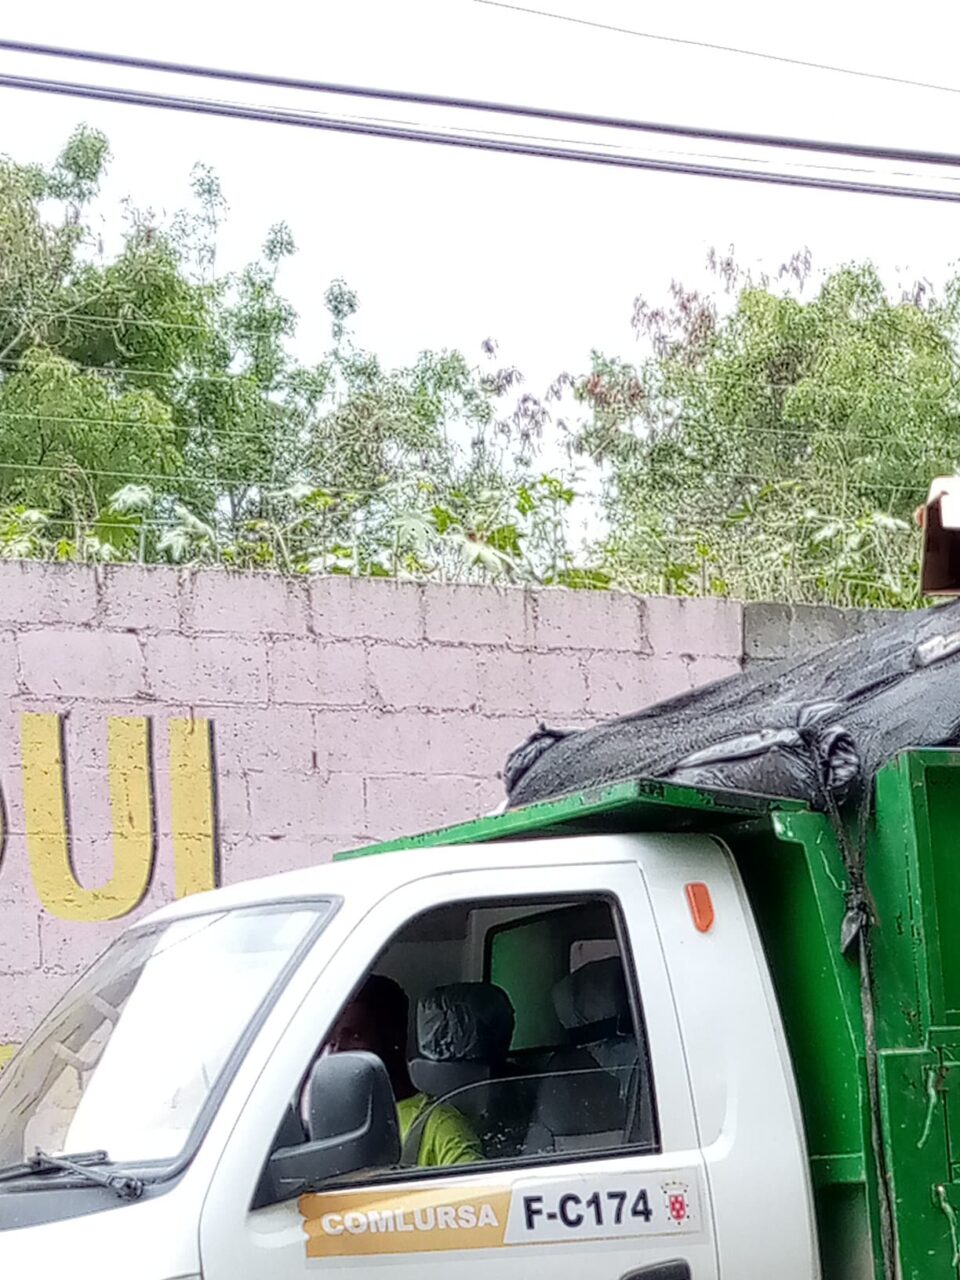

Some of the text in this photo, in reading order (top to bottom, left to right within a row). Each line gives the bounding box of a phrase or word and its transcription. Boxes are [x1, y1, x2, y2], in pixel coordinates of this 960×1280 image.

[0, 712, 222, 922] UI
[320, 1187, 654, 1236] COMLURSA F-C174
